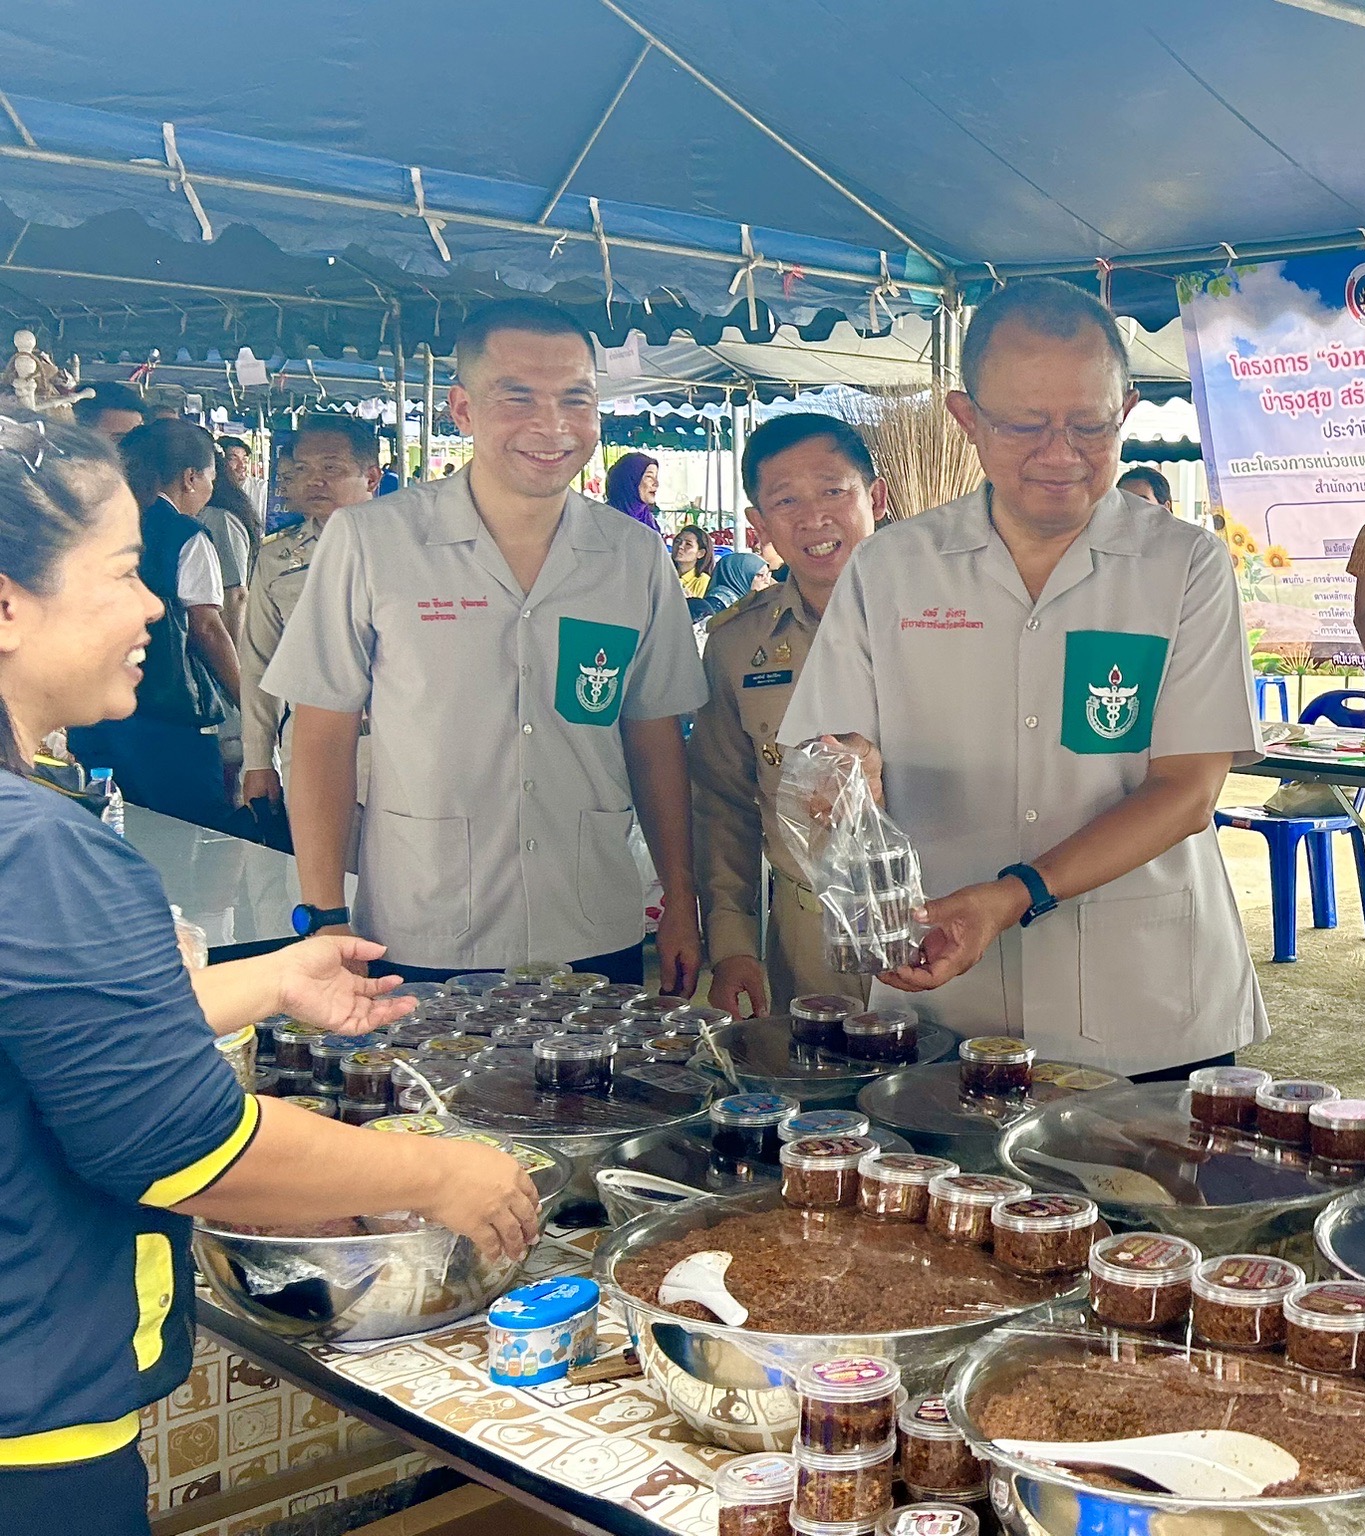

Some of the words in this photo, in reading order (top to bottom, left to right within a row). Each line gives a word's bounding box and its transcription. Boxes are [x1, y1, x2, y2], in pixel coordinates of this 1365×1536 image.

[1229, 353, 1309, 376] โครงการ
[1262, 387, 1332, 415] บำรุงสุข
[1282, 573, 1304, 584] พบกับ
[1313, 573, 1356, 584] การจำหน่าย
